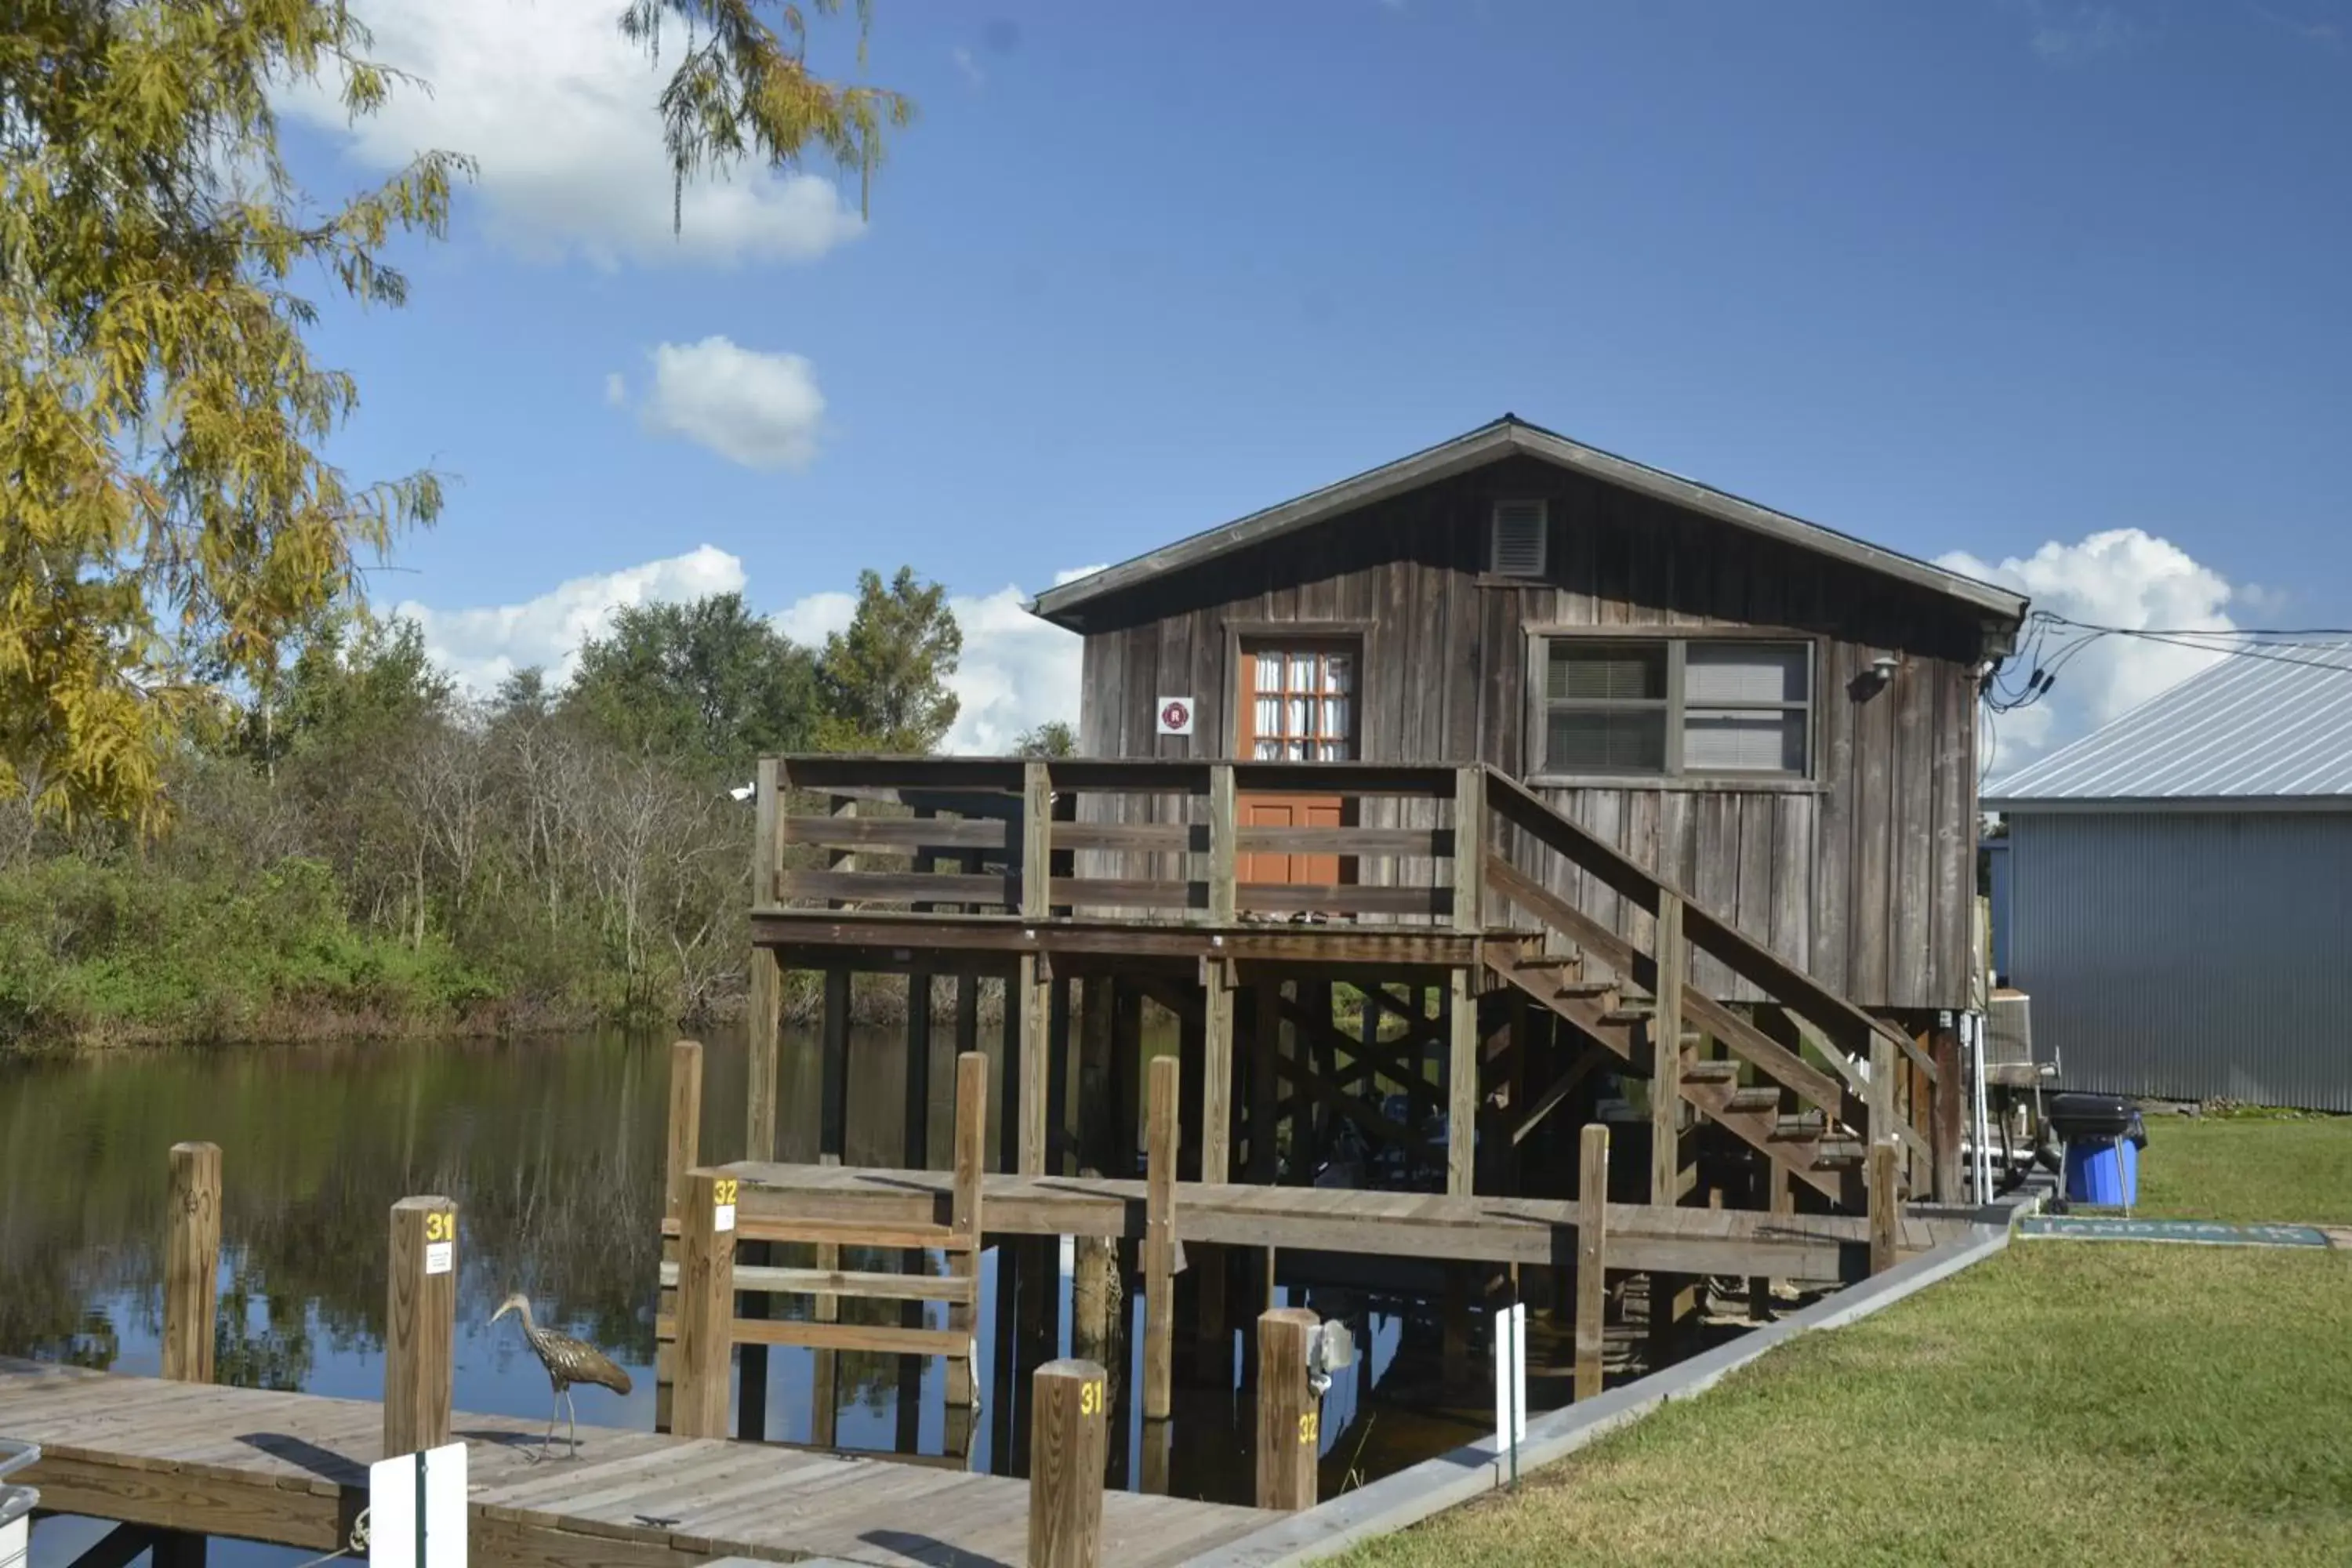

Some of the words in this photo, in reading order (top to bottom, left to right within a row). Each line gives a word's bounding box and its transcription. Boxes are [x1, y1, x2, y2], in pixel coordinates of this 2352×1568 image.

[714, 1178, 738, 1205] 32
[426, 1213, 453, 1240] 31
[1081, 1380, 1102, 1414] 31
[1298, 1412, 1318, 1444] 32
